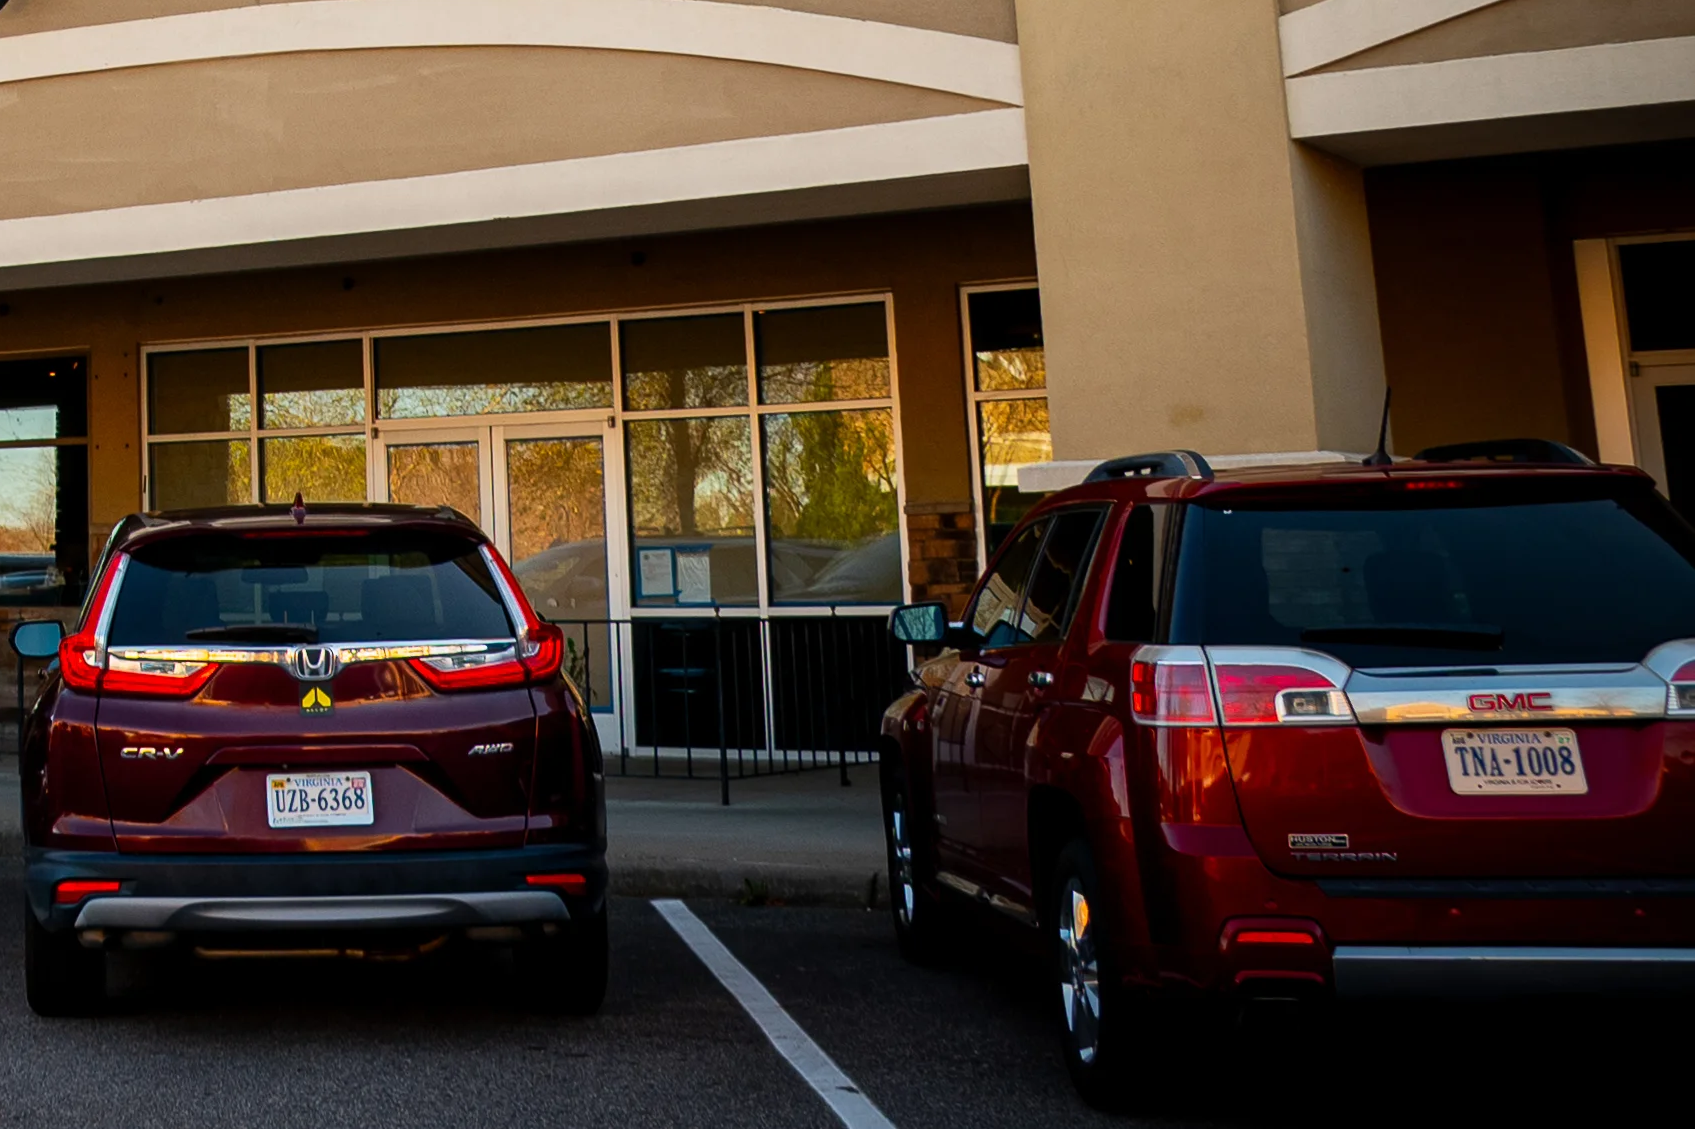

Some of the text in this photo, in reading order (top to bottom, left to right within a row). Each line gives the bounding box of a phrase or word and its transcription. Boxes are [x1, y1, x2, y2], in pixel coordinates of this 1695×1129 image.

[1467, 692, 1554, 711] GMC
[1476, 733, 1542, 745] VIRGINIA
[120, 747, 184, 760] CR-V
[467, 742, 514, 755] AWD
[294, 777, 343, 787] VIRGINIA
[274, 787, 365, 813] UZB-6368
[1290, 852, 1398, 862] TERRAIN
